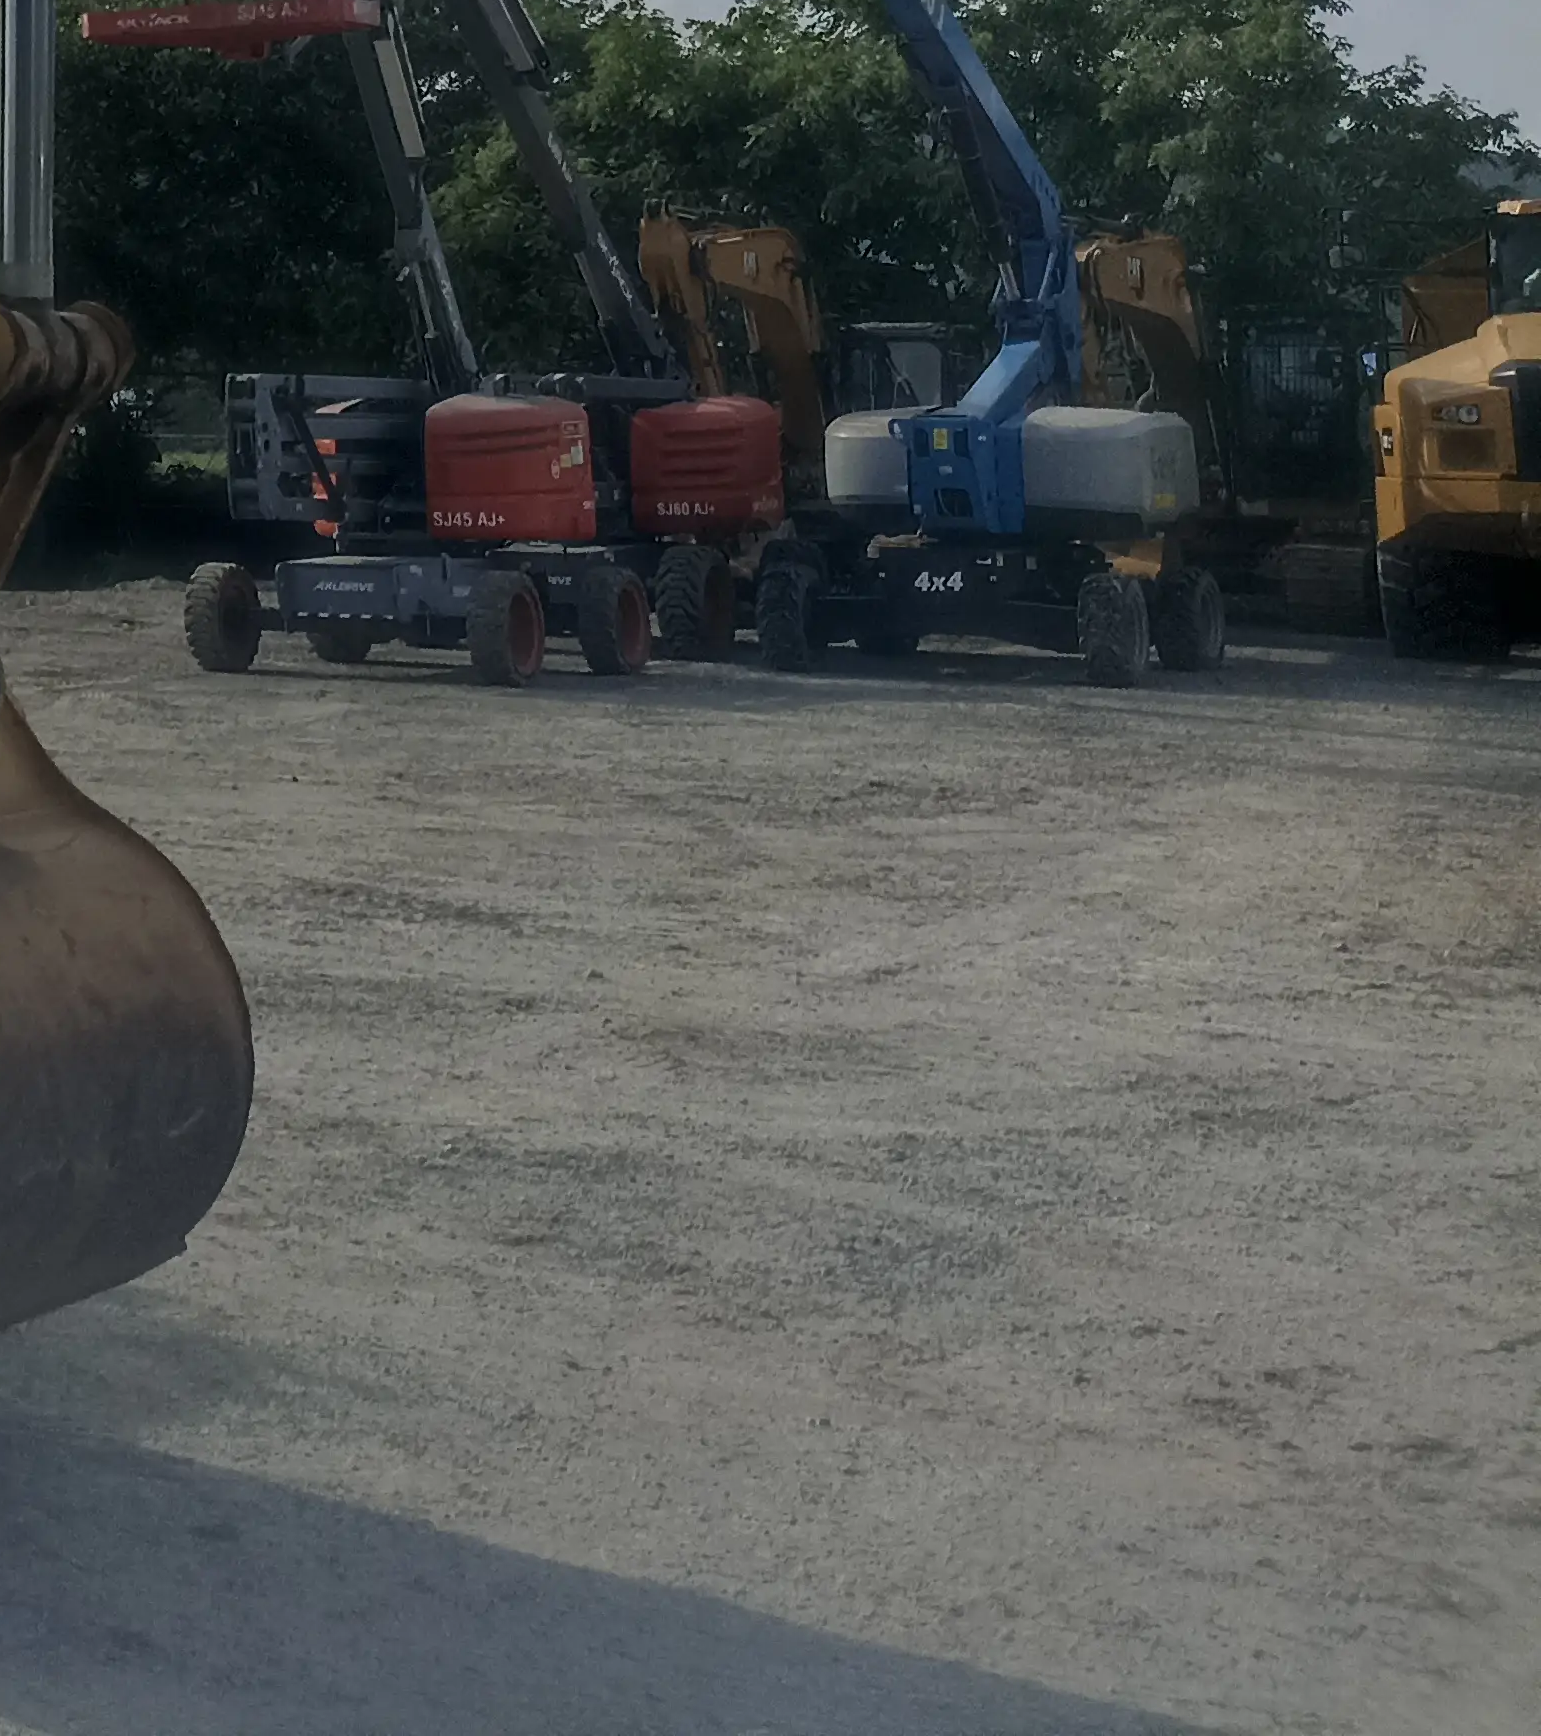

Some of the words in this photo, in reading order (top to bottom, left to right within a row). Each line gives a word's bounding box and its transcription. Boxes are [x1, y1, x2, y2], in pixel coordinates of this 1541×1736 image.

[433, 511, 473, 527] SJ45
[477, 511, 505, 527] AJ+
[914, 570, 963, 593] 4x4
